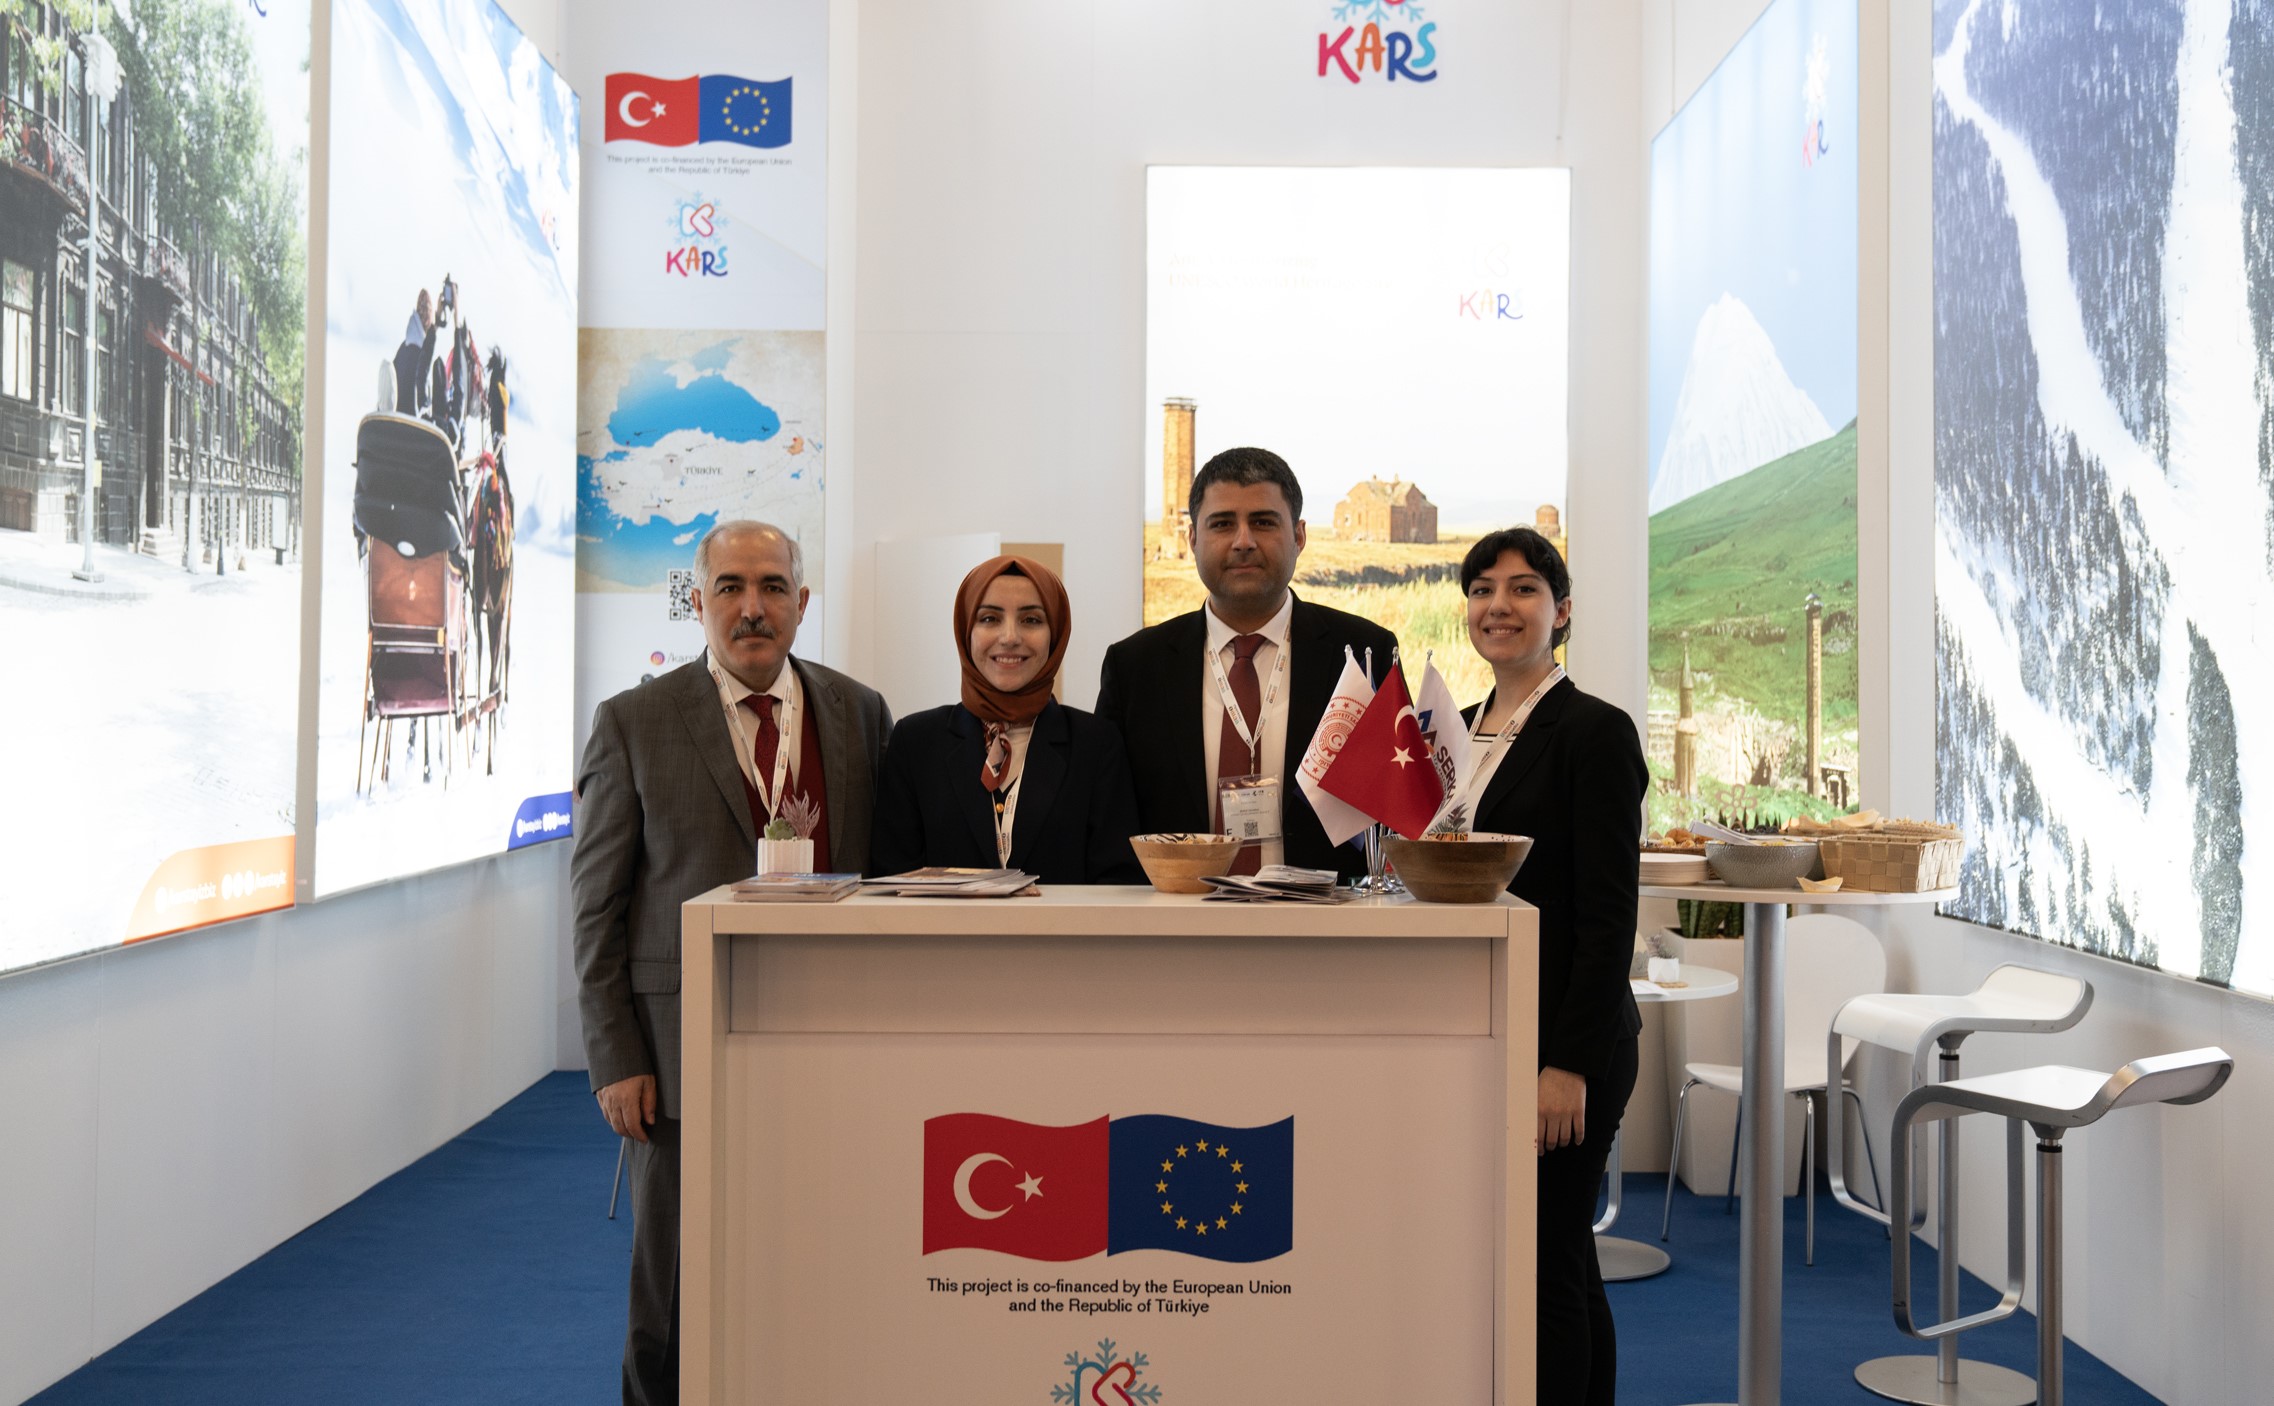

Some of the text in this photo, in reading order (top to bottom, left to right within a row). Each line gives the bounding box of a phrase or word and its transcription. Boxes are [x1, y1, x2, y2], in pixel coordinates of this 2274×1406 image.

[1318, 22, 1437, 84] KARS
[608, 155, 622, 163] This
[624, 156, 650, 165] project
[661, 156, 704, 164] co-financed
[706, 157, 715, 165] by
[731, 157, 768, 166] European
[770, 158, 793, 166] Union
[678, 167, 711, 176] Republic
[666, 246, 728, 277] KARS
[927, 1277, 1292, 1297] This project is co-financed by the European Union
[1009, 1298, 1210, 1317] and the Republic of Türkiye
